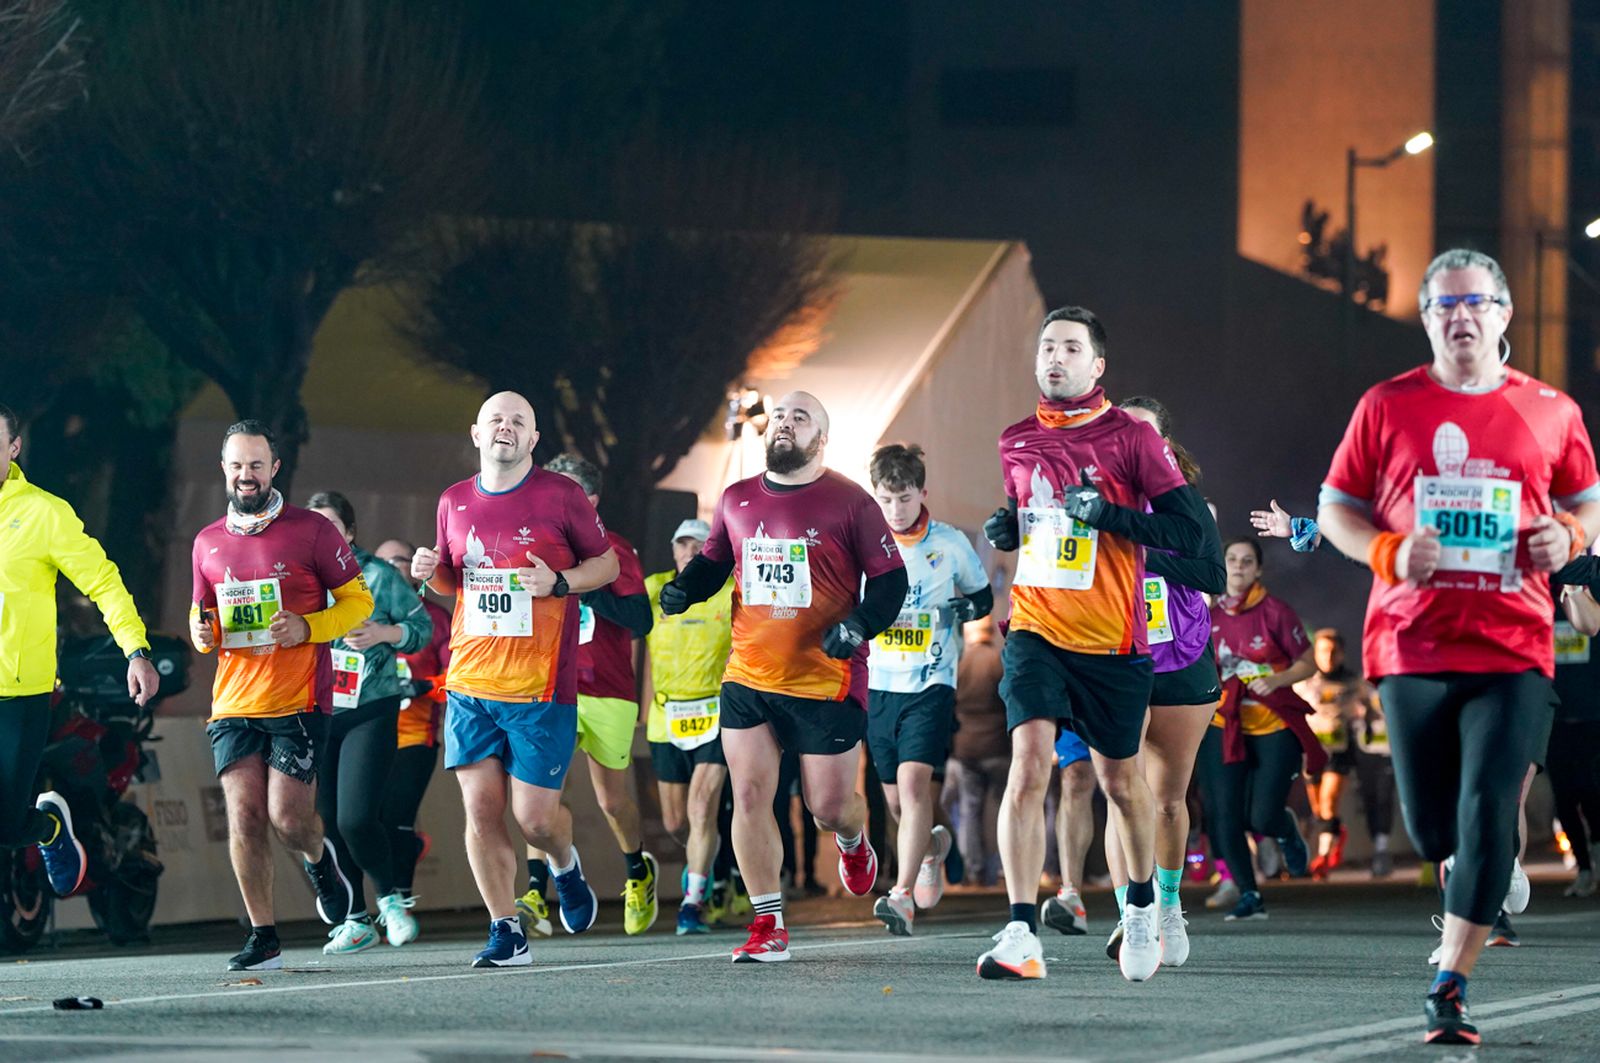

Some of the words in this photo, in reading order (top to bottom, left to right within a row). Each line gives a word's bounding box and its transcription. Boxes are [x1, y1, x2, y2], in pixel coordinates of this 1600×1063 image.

[1435, 510, 1498, 541] 6015
[756, 563, 794, 584] 1743
[478, 593, 512, 613] 490
[232, 604, 263, 625] 491
[884, 629, 924, 646] 5980
[680, 716, 713, 733] 8427
